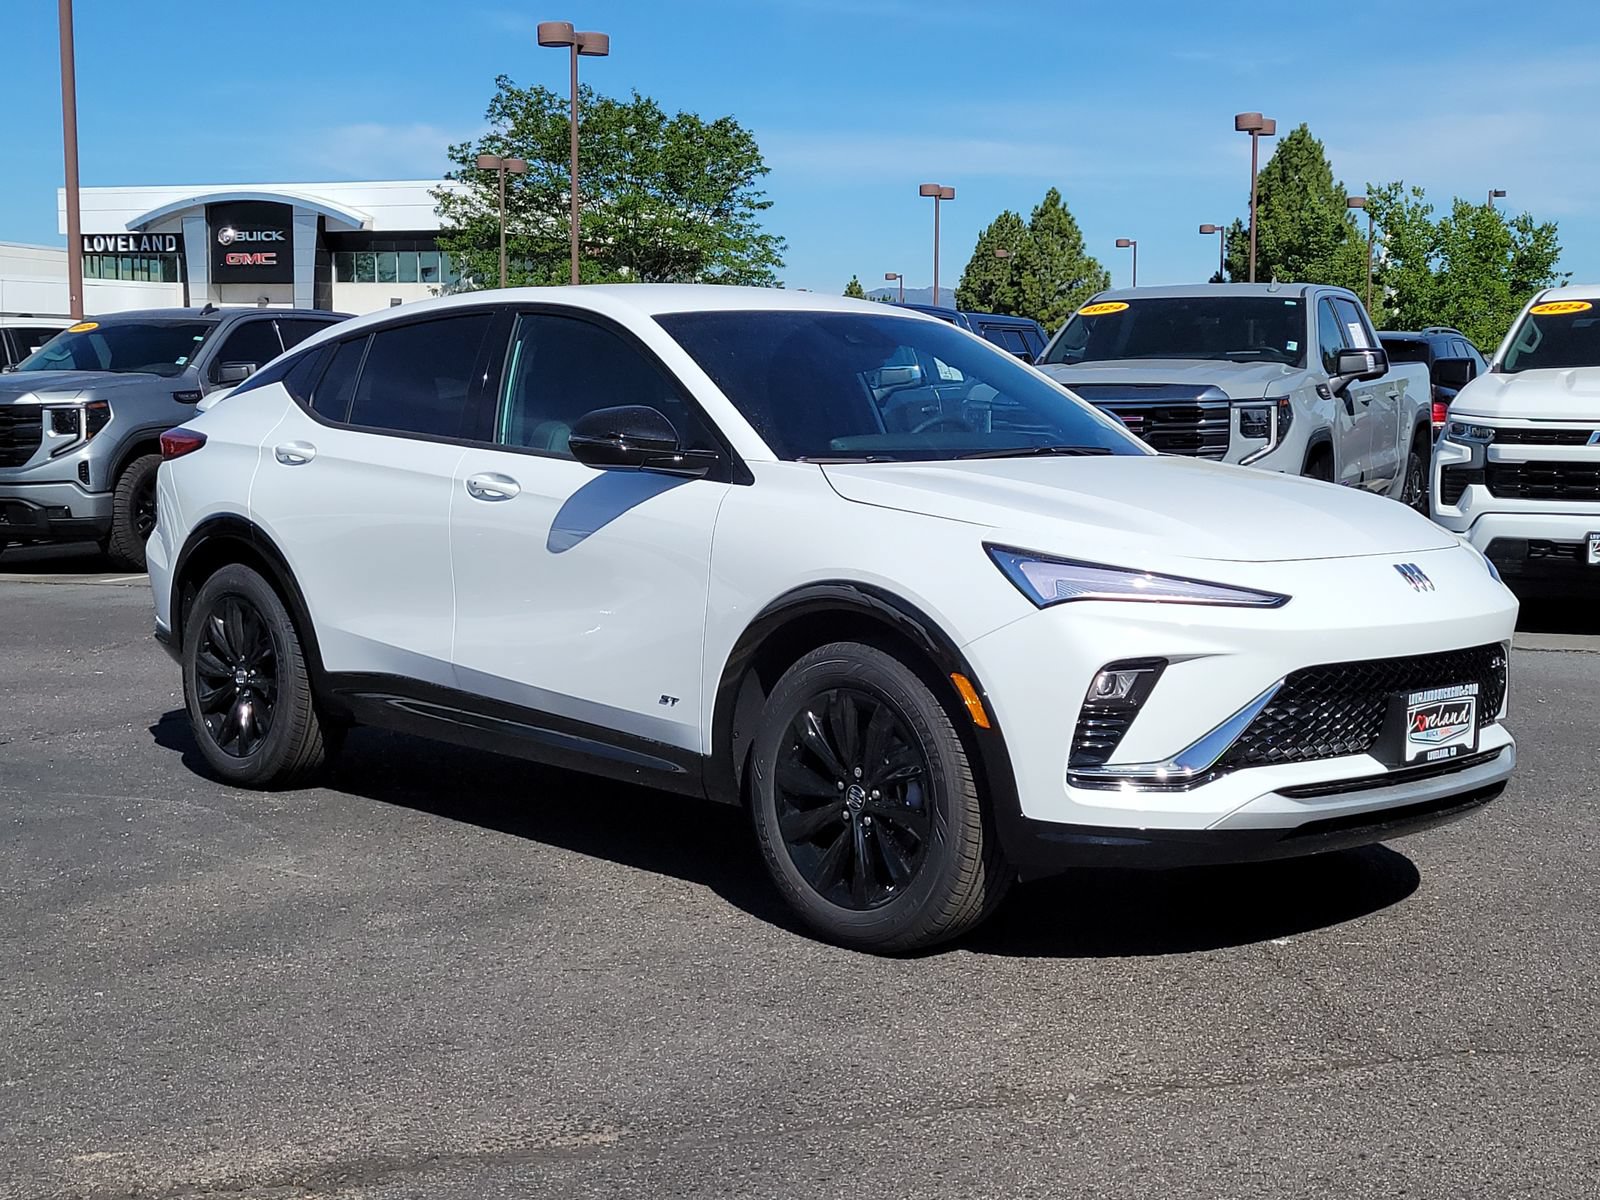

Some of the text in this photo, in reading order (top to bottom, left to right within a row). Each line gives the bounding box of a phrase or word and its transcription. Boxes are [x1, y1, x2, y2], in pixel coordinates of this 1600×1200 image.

[234, 230, 286, 241] BUICK
[83, 235, 177, 252] LOVELAND
[226, 252, 277, 265] GMC
[1535, 303, 1585, 312] 2024
[658, 694, 681, 707] ST
